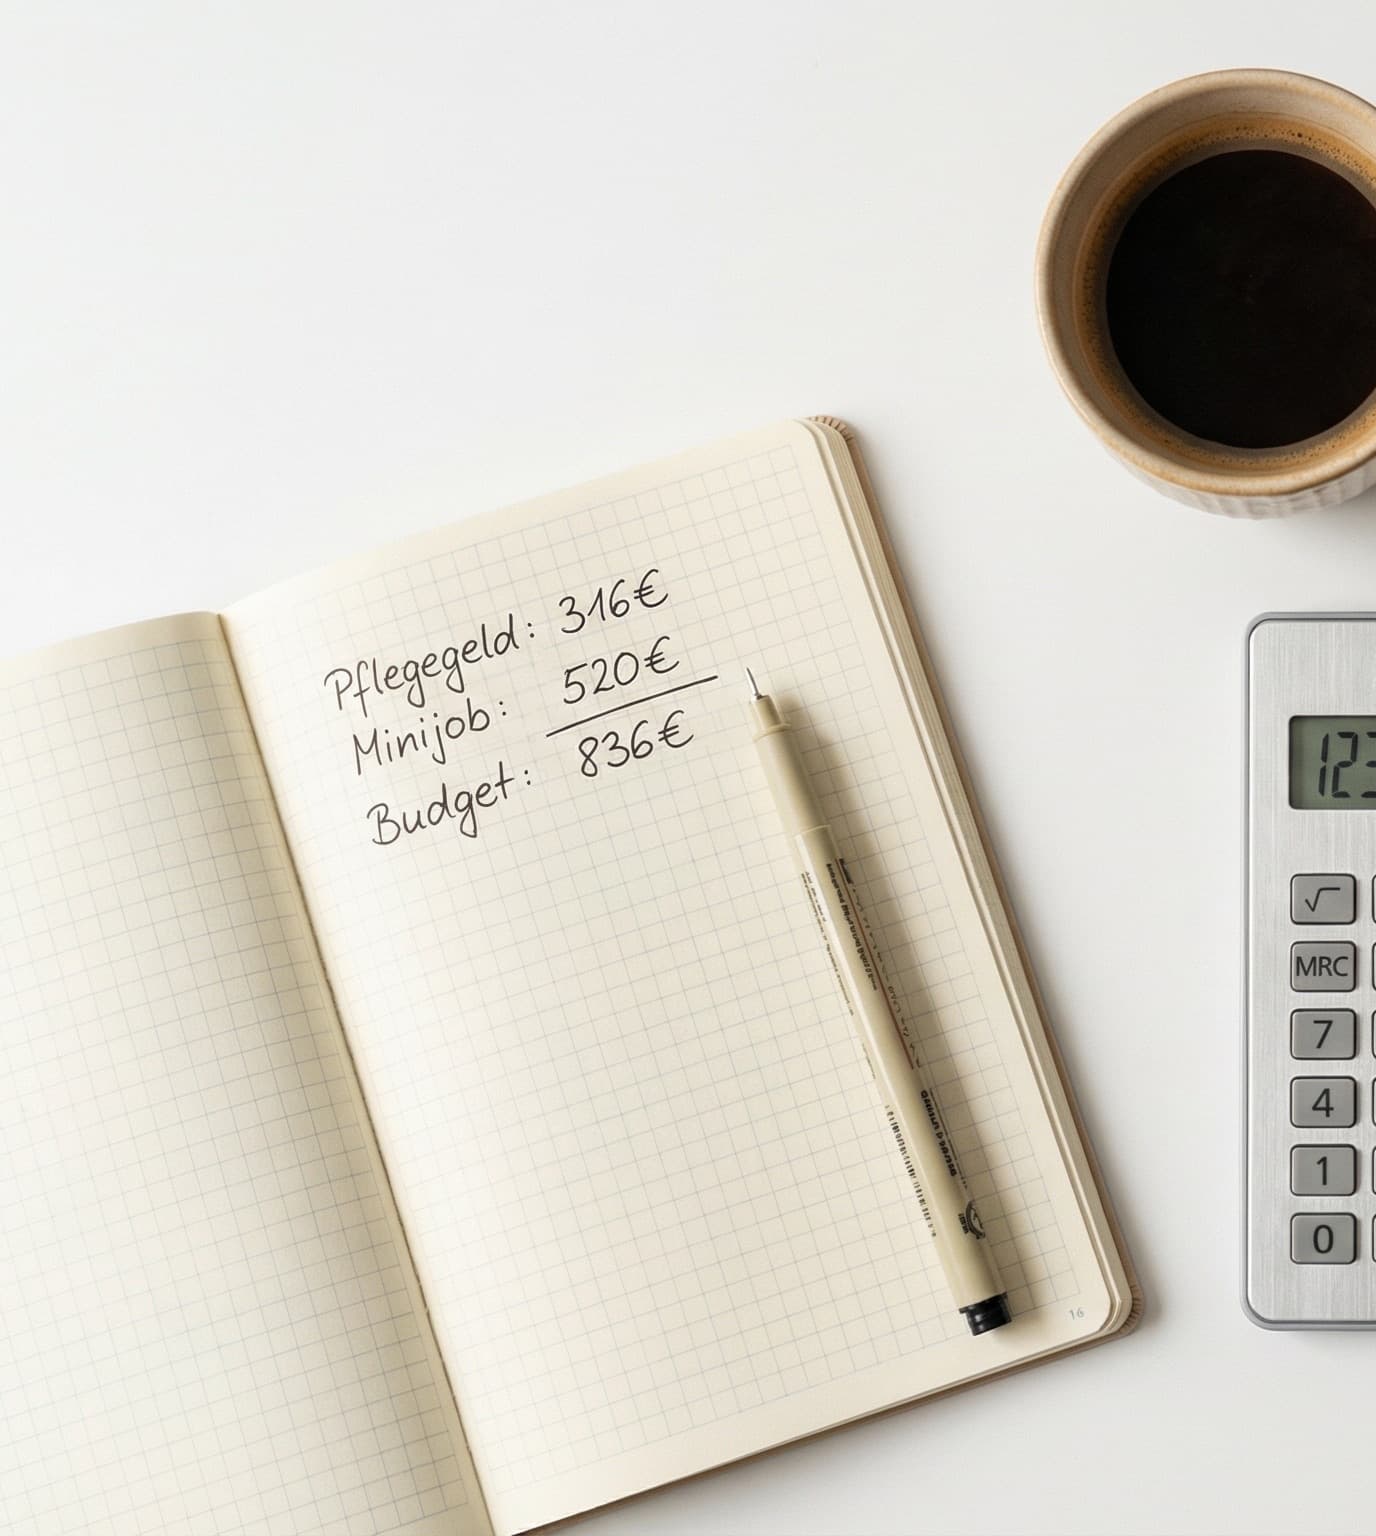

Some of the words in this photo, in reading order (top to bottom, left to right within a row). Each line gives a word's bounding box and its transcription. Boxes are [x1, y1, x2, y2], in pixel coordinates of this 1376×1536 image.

[323, 613, 536, 718] Pflegegeld:
[559, 568, 669, 634] 316€
[353, 697, 507, 775] Minijob:
[563, 636, 680, 704] 520€
[366, 761, 532, 845] Budget:
[578, 709, 695, 777] 836€
[1295, 956, 1349, 977] MRC
[1313, 1020, 1333, 1049] 7
[1311, 1088, 1334, 1117] 4
[1315, 1156, 1328, 1185] 1
[1312, 1225, 1334, 1254] 0
